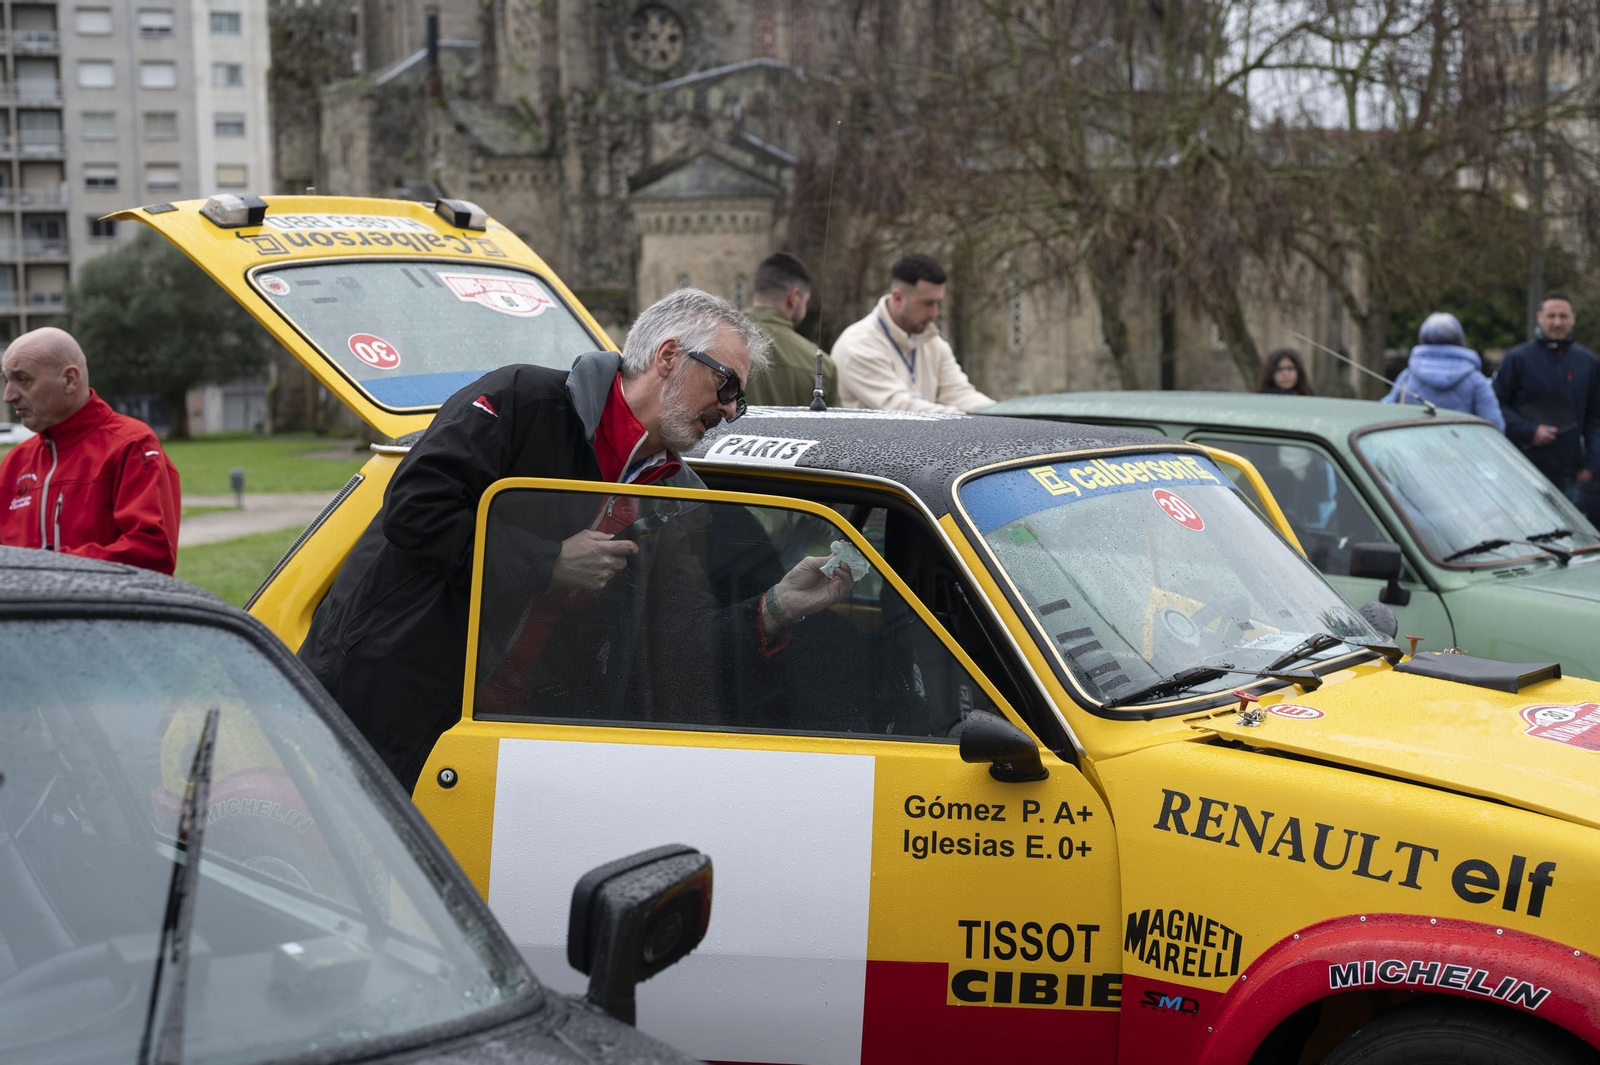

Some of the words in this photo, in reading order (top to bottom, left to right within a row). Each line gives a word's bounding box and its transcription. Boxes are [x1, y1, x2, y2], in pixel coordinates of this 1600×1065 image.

[267, 216, 323, 229] BBD
[281, 231, 472, 254] Calberson
[354, 341, 396, 363] 30
[715, 437, 808, 460] PARIS
[1069, 458, 1198, 489] calberson
[1158, 496, 1196, 522] 30
[1541, 710, 1569, 720] 30
[904, 795, 1006, 822] Gómez
[1022, 799, 1045, 824] P.
[1053, 801, 1093, 825] A+
[903, 829, 1015, 860] Iglesias
[1025, 834, 1052, 859] E.
[1153, 788, 1439, 890] RENAULT
[1451, 854, 1557, 918] elf
[958, 919, 1100, 963] TISSOT
[1124, 909, 1243, 958] MAGNETI
[1124, 930, 1242, 977] MARELLI
[951, 969, 1123, 1008] CIBIE
[1329, 959, 1552, 1010] MICHELIN
